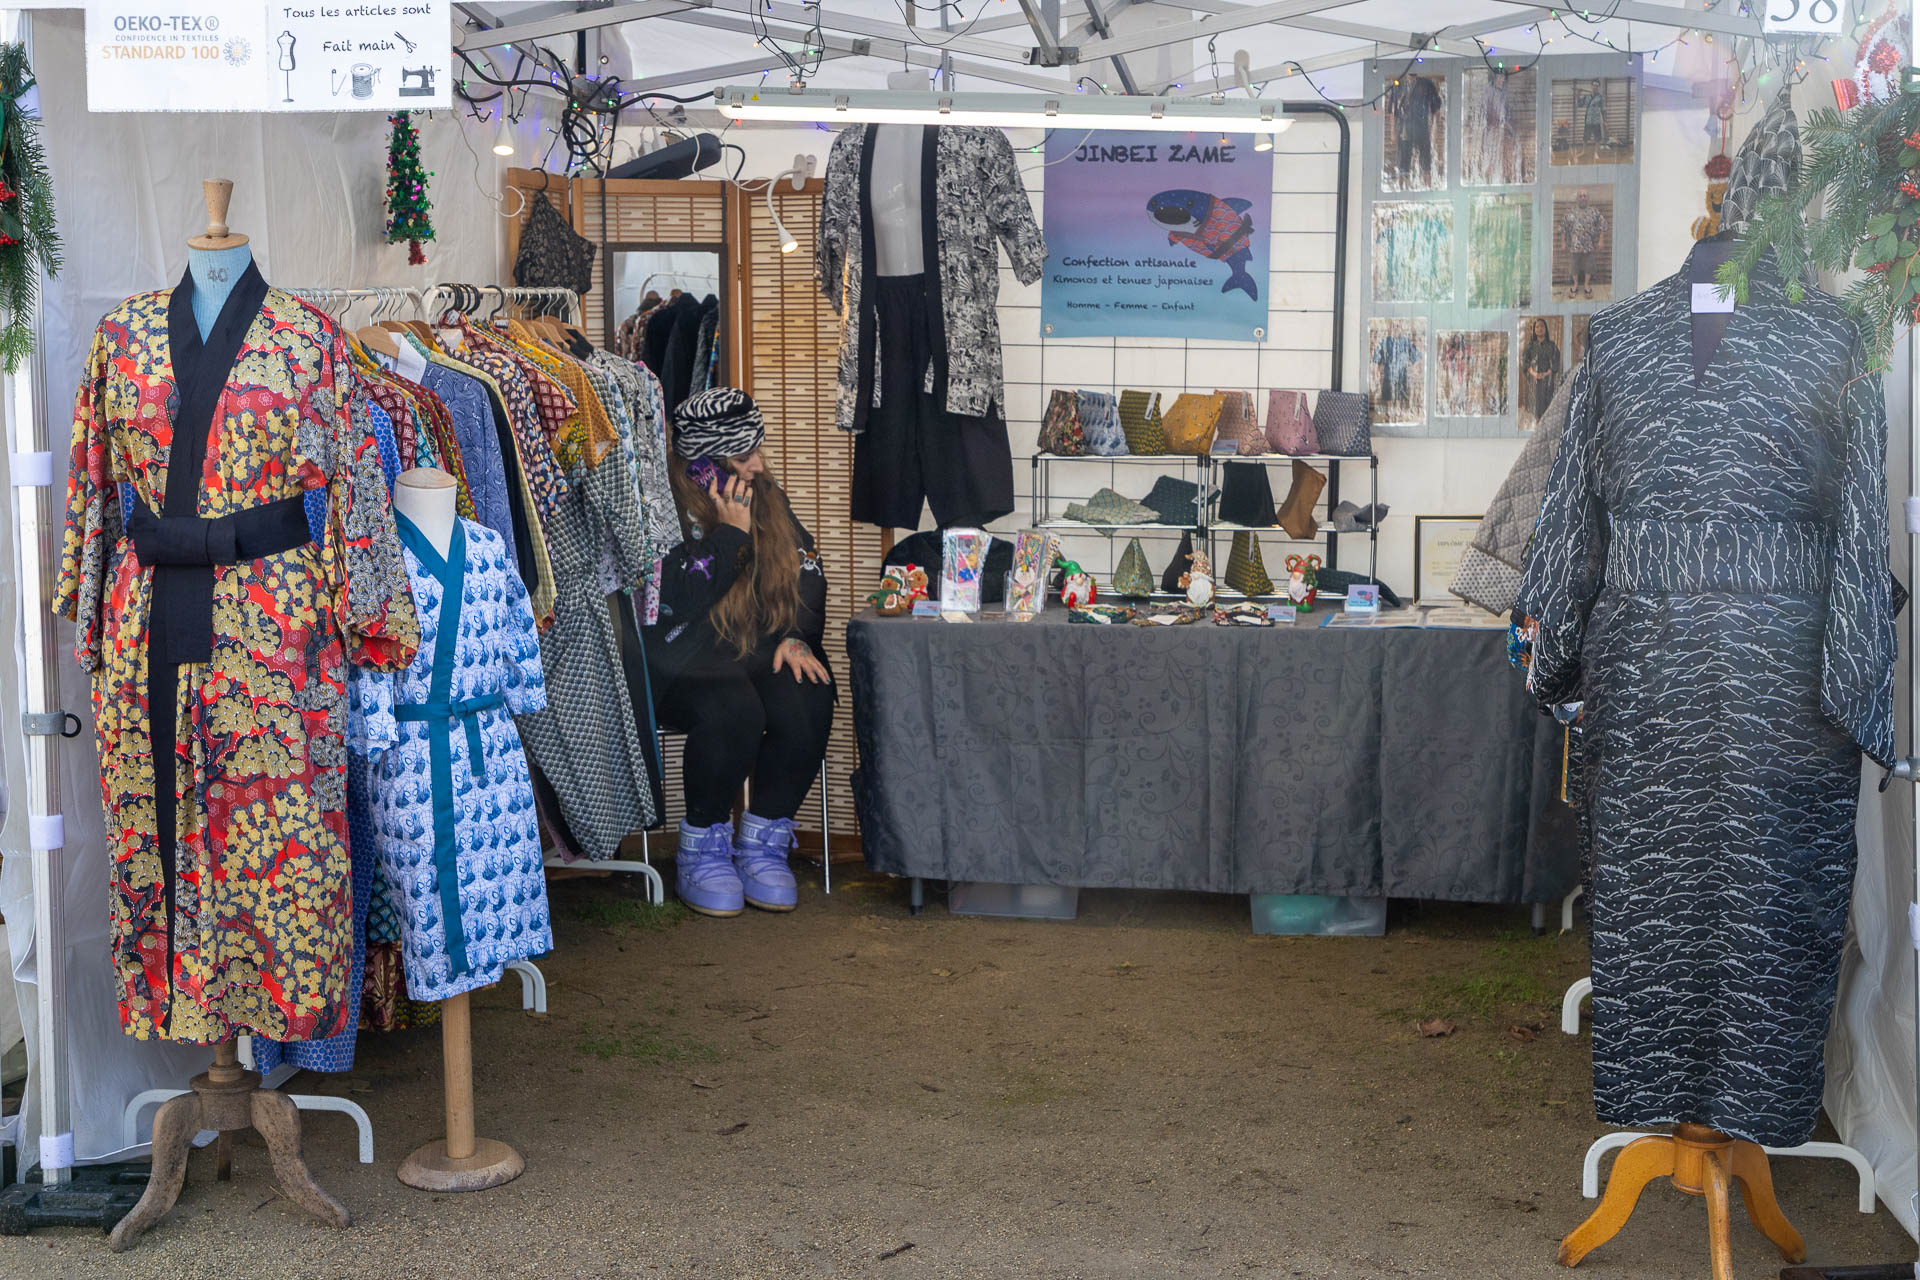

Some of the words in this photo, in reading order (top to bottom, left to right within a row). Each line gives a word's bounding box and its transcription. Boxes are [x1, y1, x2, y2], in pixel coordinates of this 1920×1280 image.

[283, 8, 315, 18] Tous
[321, 7, 339, 17] les
[345, 5, 396, 17] articles
[402, 4, 431, 15] sont
[102, 45, 186, 60] STANDARD
[191, 46, 219, 59] 100
[323, 40, 352, 52] Fait
[359, 40, 395, 51] main
[1075, 145, 1158, 163] JINBEI
[1168, 145, 1236, 164] ZAME
[1062, 255, 1129, 268] Confection
[1135, 257, 1198, 268] artisanale
[1053, 275, 1097, 285] Kimonos
[1102, 275, 1112, 285] et
[1117, 275, 1152, 286] tenues
[1155, 275, 1214, 289] japonaises
[1067, 301, 1100, 310] Homme
[1113, 301, 1149, 310] Femme
[1161, 302, 1195, 312] Enfant
